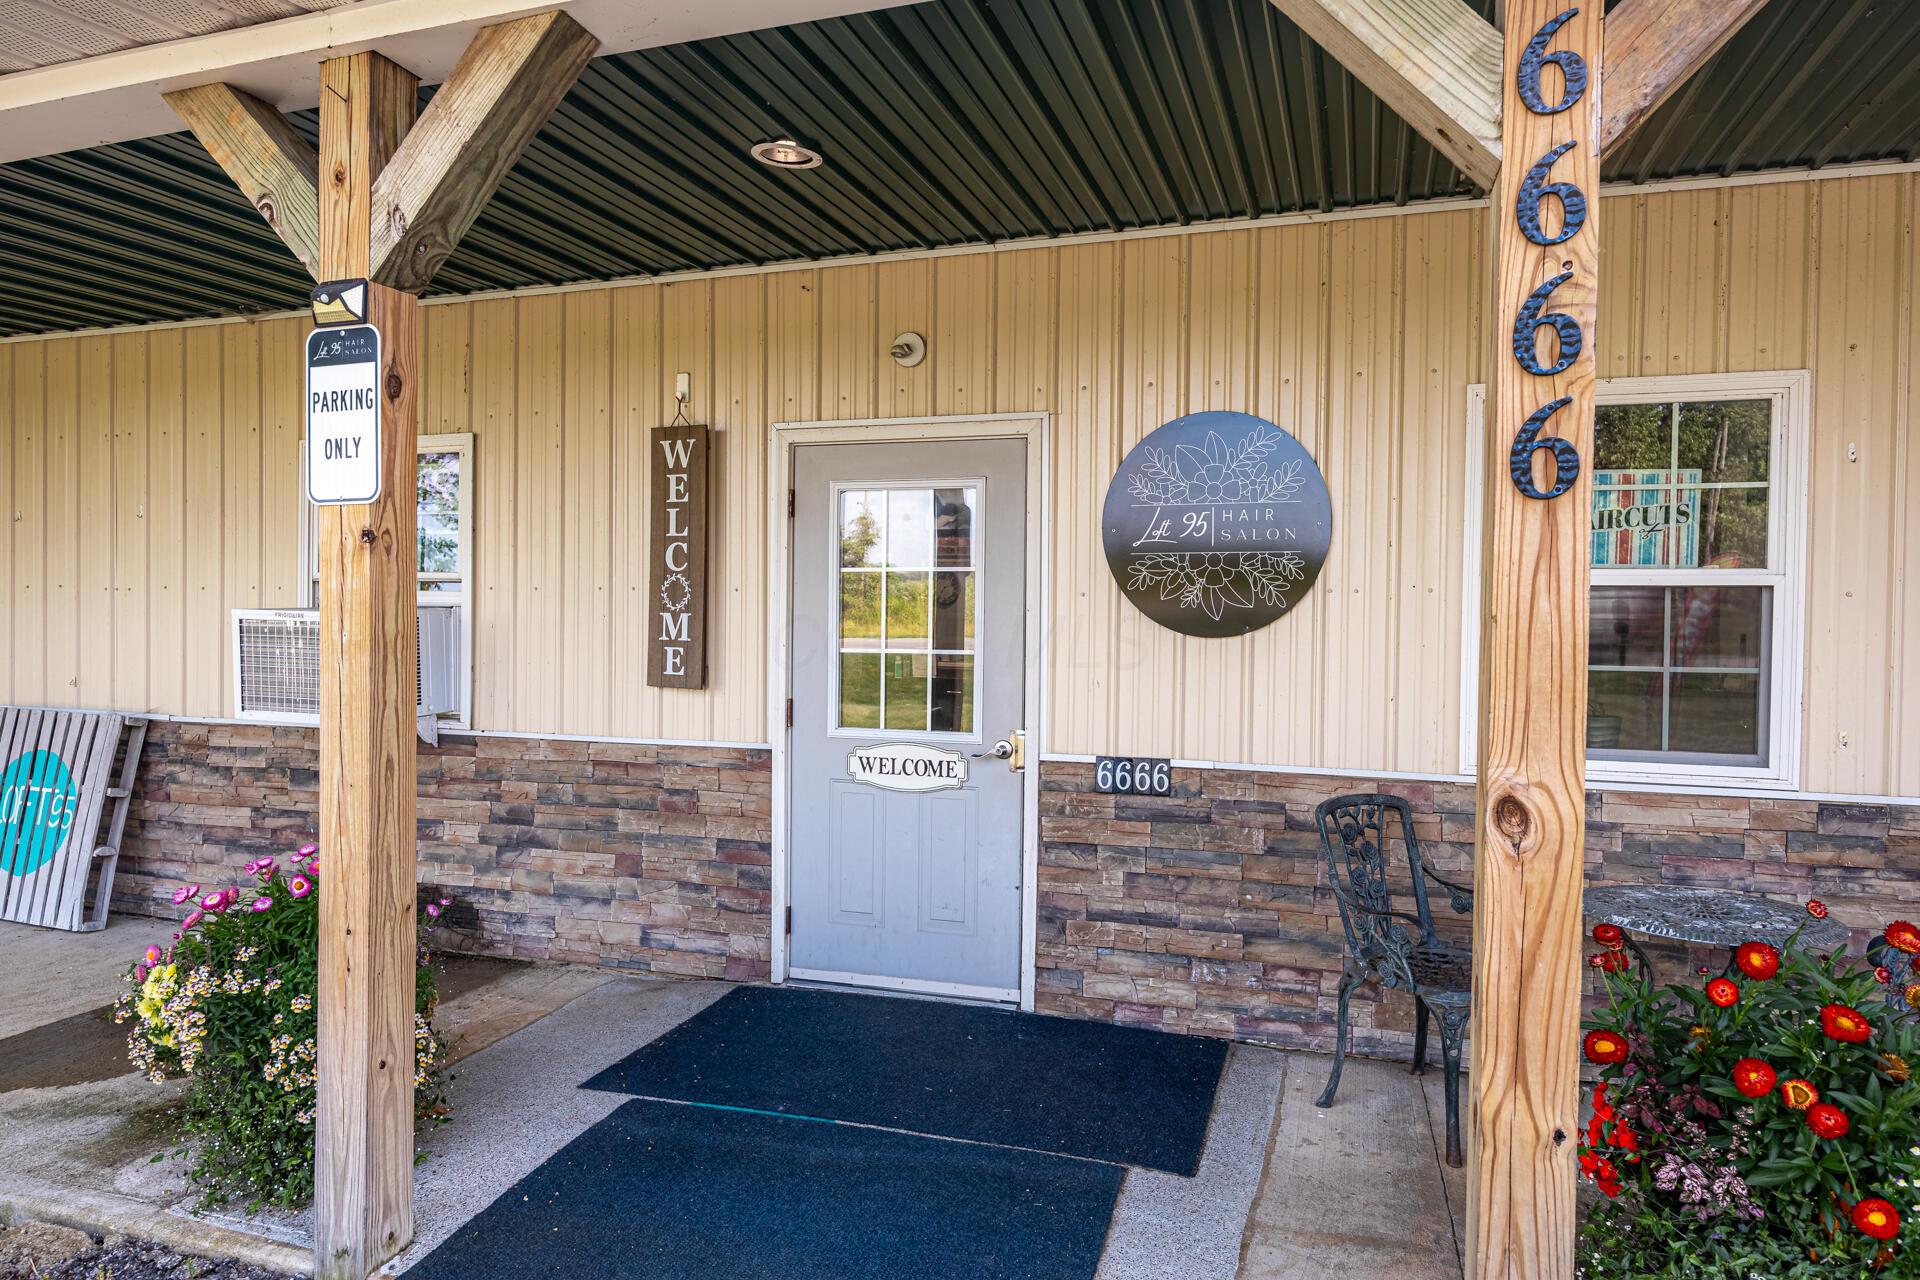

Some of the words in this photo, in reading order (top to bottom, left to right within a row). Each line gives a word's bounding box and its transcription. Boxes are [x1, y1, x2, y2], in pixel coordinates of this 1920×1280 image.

[330, 341, 342, 355] 95
[345, 338, 365, 347] HAIR
[312, 387, 374, 413] PARKING
[324, 437, 362, 460] ONLY
[1222, 508, 1275, 521] HAIR
[1132, 507, 1178, 547] Loft
[1179, 511, 1211, 538] 95
[1220, 527, 1297, 542] SALON
[857, 755, 958, 779] WELCOME
[1097, 760, 1170, 792] 6666
[0, 785, 60, 825] OFT
